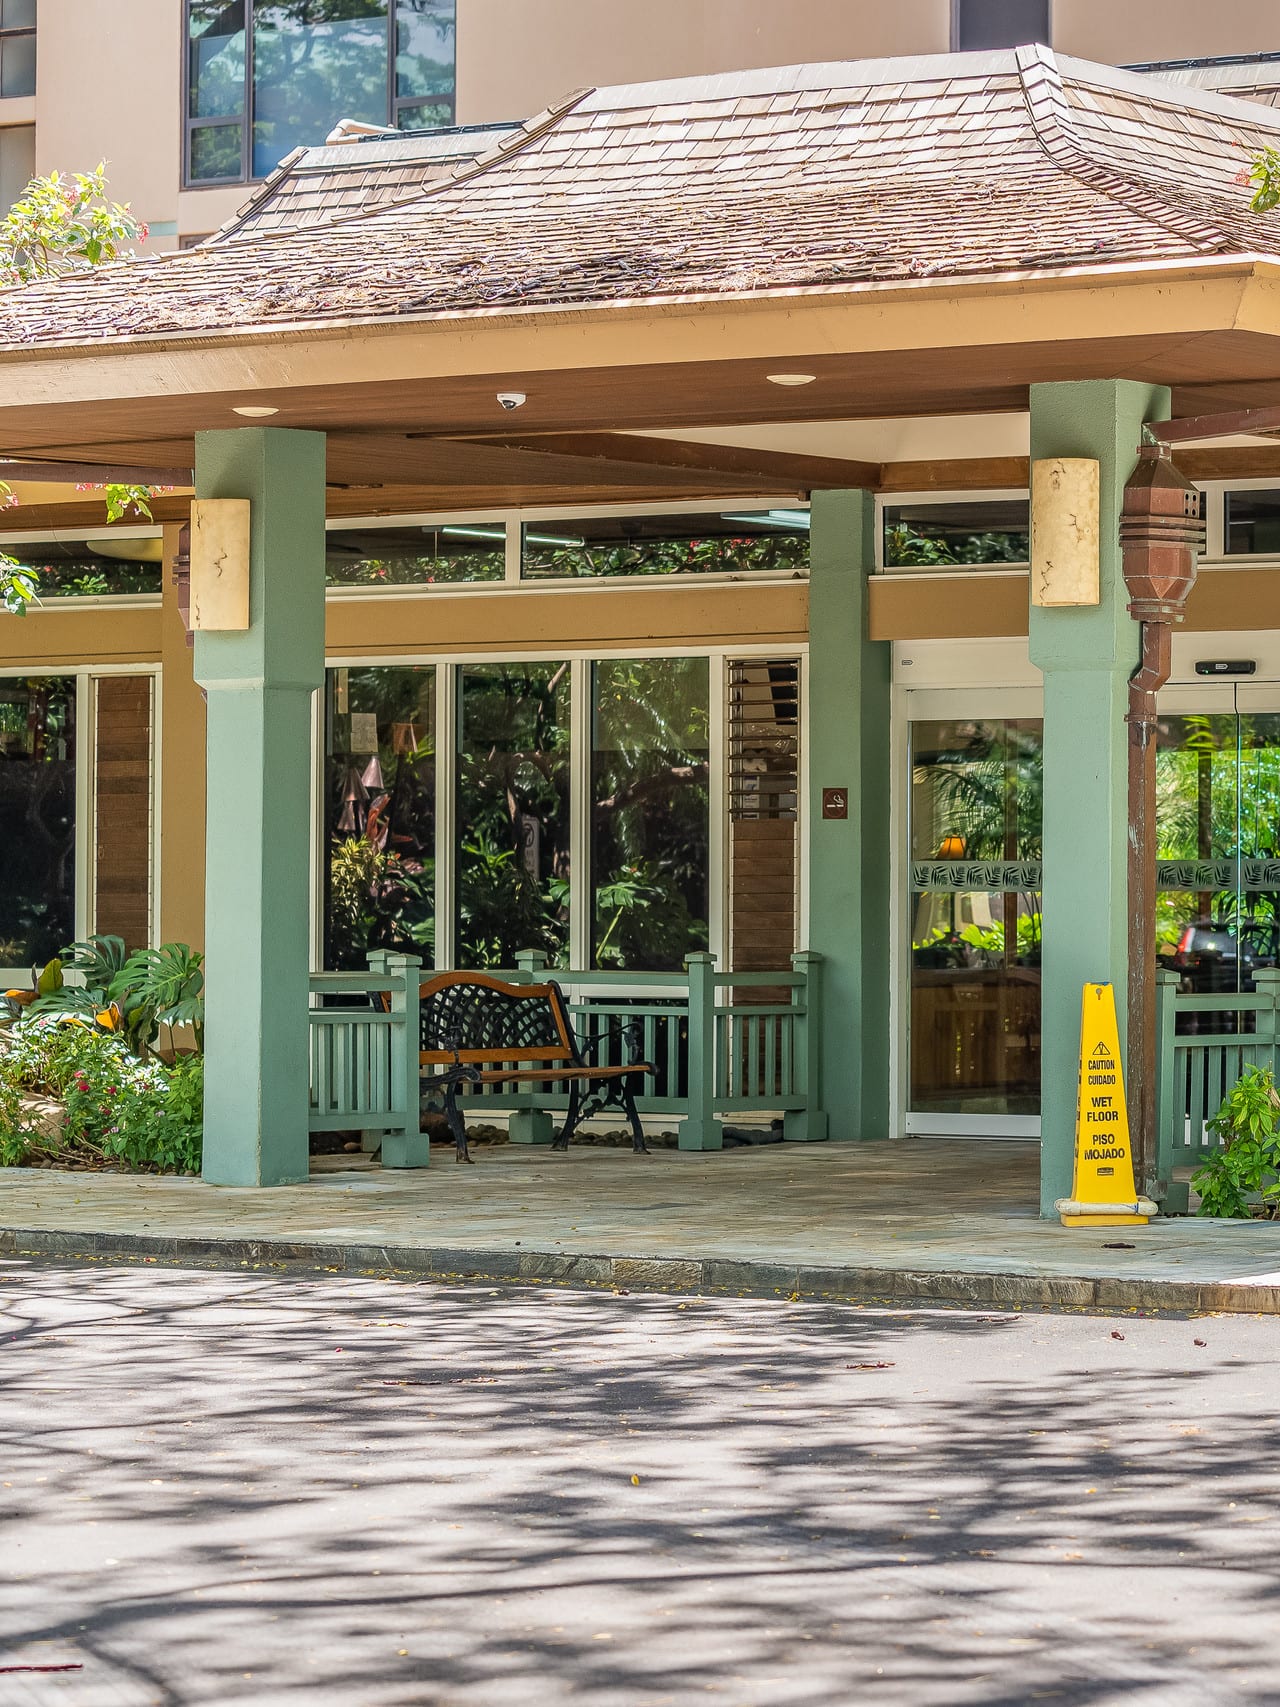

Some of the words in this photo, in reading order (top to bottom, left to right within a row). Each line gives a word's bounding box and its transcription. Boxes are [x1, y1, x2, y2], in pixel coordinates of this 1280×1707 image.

[1088, 1060, 1115, 1070] CAUTION
[1088, 1075, 1116, 1085] CUIDADO
[1092, 1097, 1113, 1107] WET
[1087, 1111, 1118, 1122] FLOOR
[1092, 1134, 1115, 1145] PISO
[1084, 1148, 1125, 1160] MOJADO
